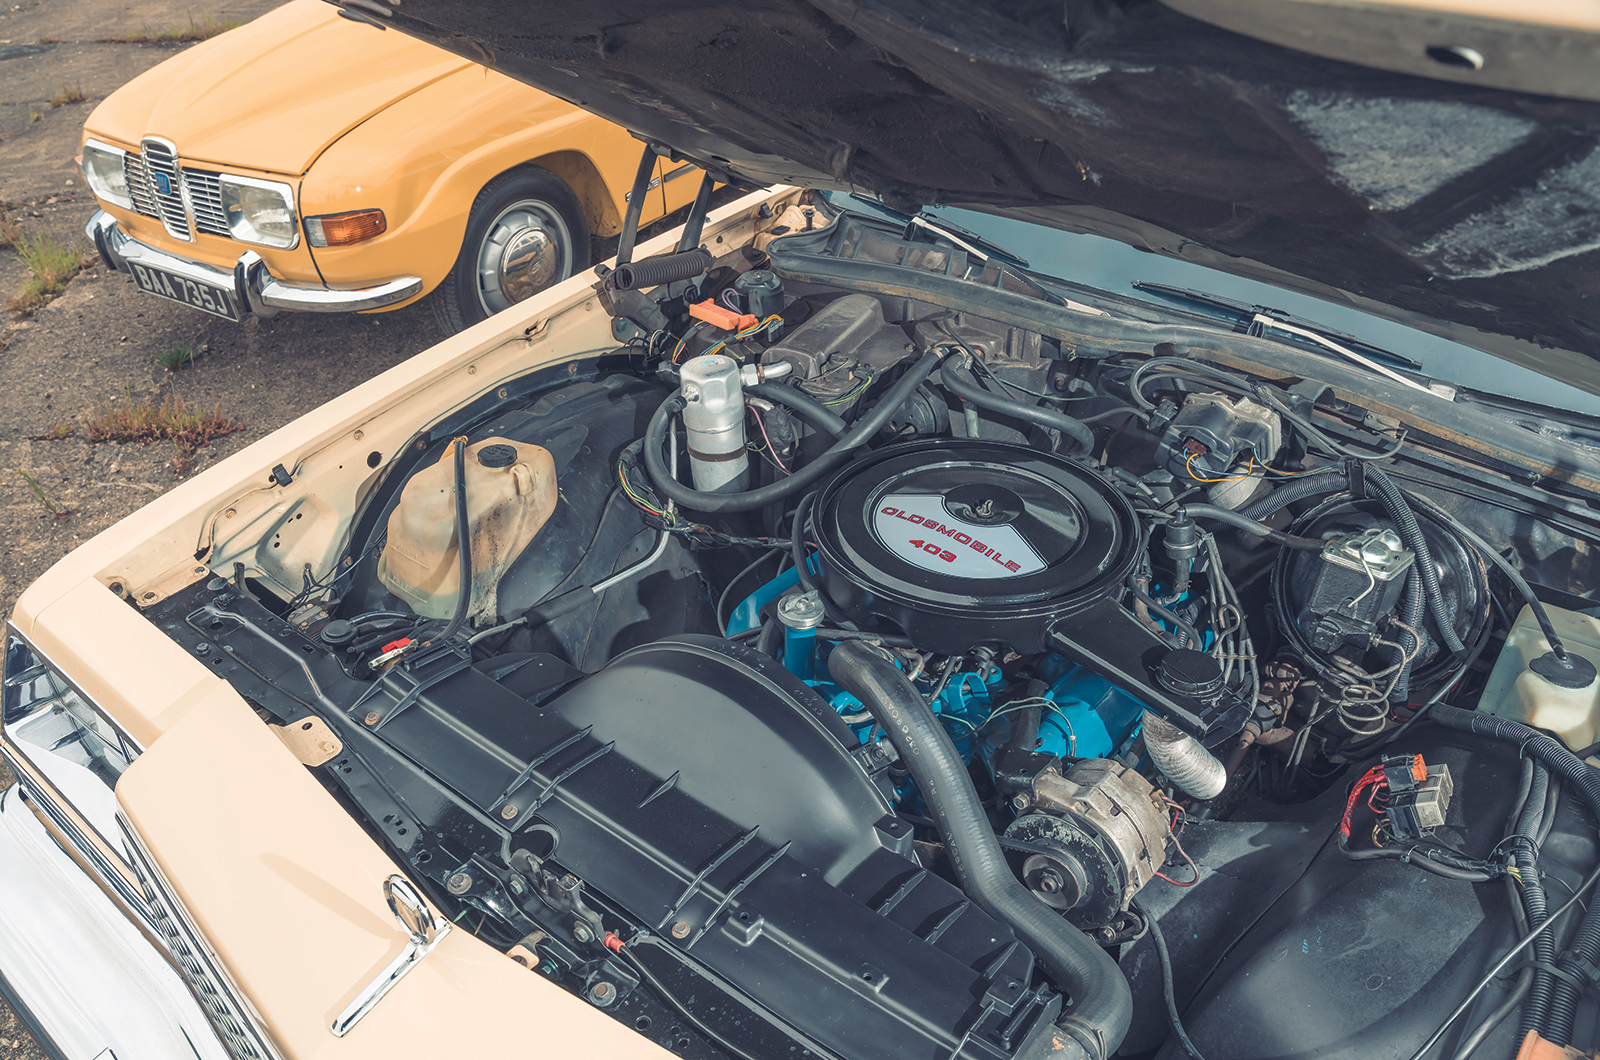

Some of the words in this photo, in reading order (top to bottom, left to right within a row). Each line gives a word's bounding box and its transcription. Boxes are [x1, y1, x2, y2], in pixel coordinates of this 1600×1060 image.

[134, 264, 178, 299] BAA
[174, 276, 228, 315] 735J
[881, 506, 1022, 573] OLDSMOBILE
[909, 538, 957, 563] 403
